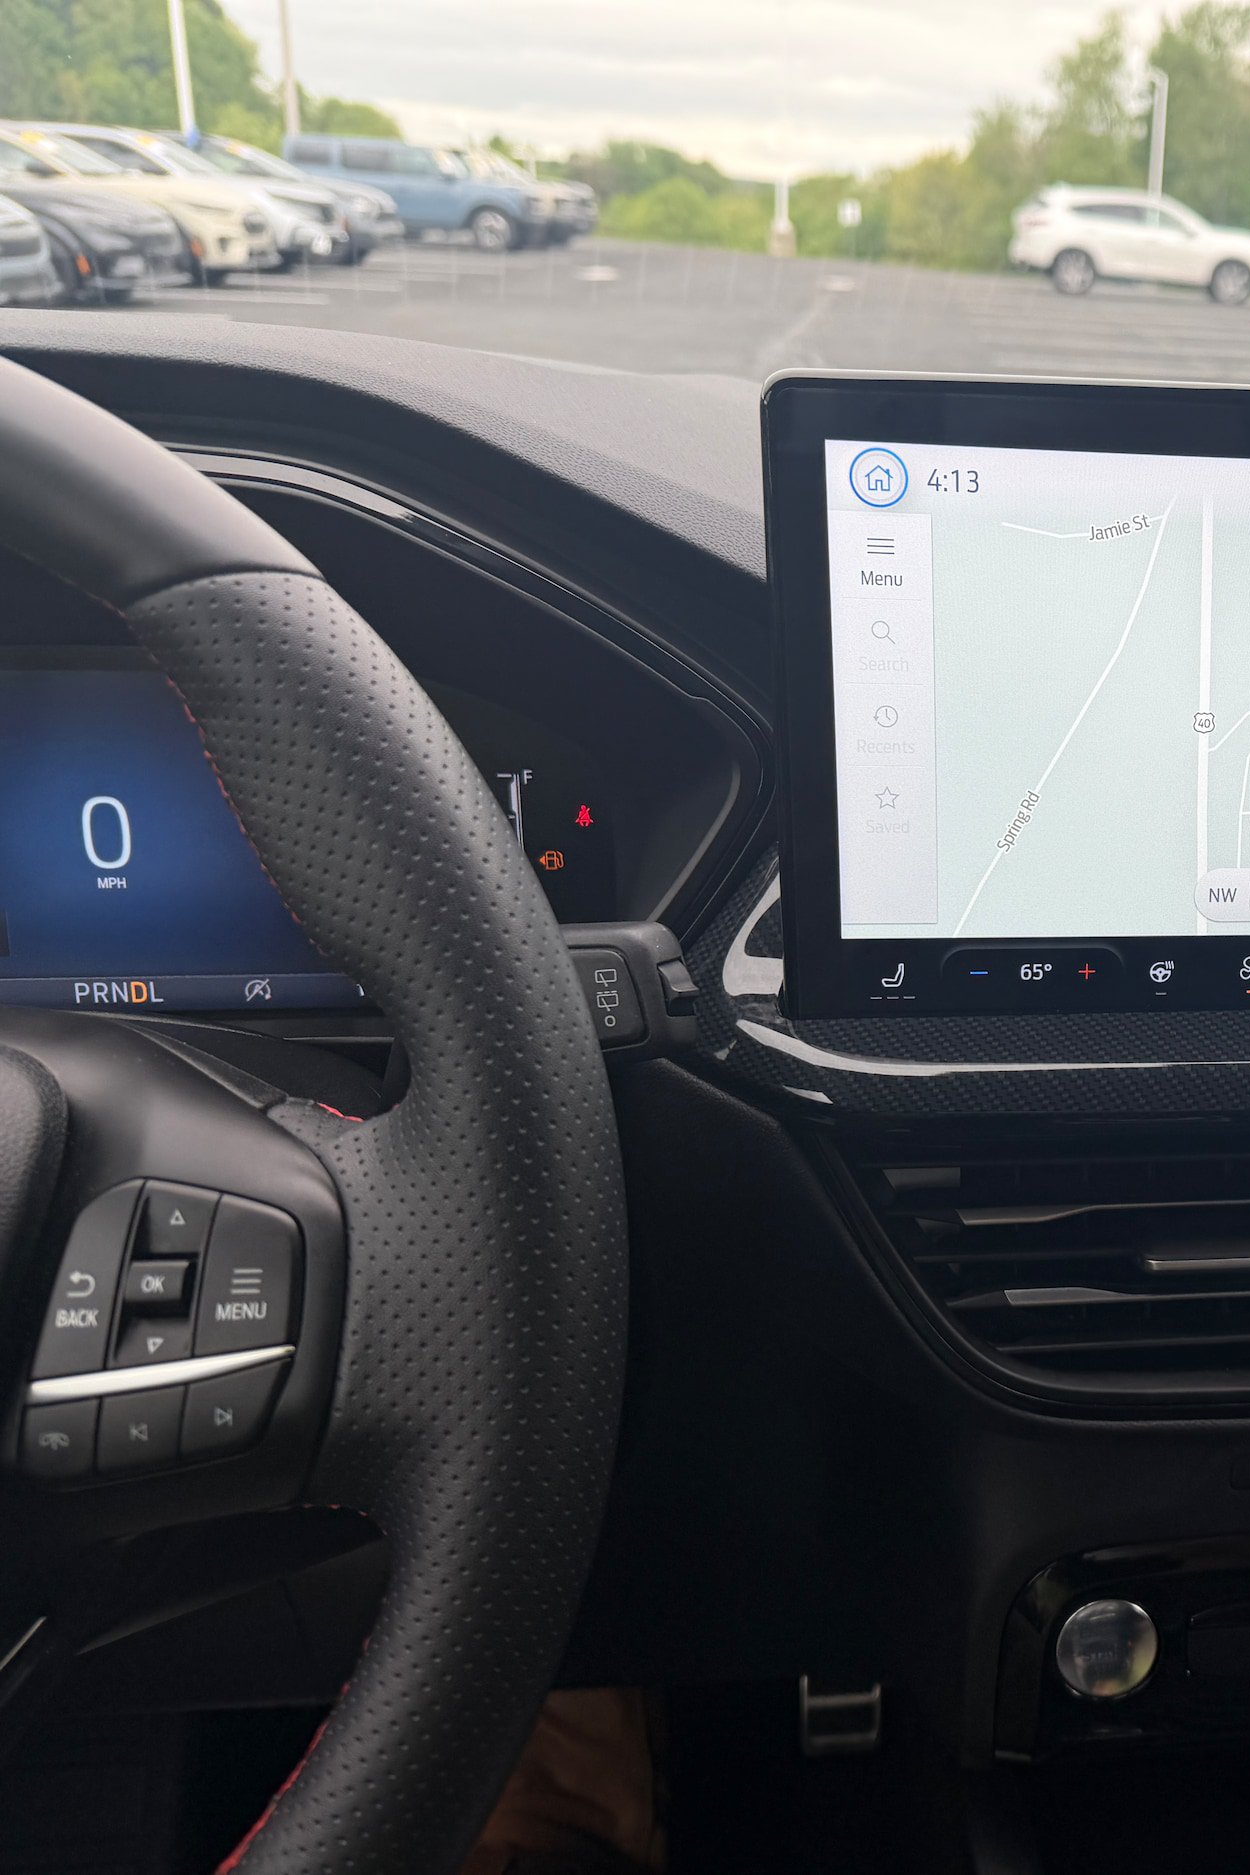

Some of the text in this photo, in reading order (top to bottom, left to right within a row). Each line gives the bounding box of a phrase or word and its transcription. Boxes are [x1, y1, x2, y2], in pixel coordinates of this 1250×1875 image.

[926, 467, 980, 494] 4:13
[1089, 514, 1150, 541] Jamie St
[860, 570, 904, 588] Menu
[858, 656, 910, 672] Search
[1197, 718, 1211, 729] 40
[857, 738, 916, 755] Recents
[522, 769, 533, 784] F
[866, 820, 910, 834] Saved
[997, 790, 1040, 852] Spring Rd
[81, 795, 132, 869] 0
[97, 876, 127, 889] MPH
[1208, 887, 1238, 903] NW
[1020, 962, 1053, 981] 65°
[141, 1274, 165, 1294] OK
[55, 1308, 100, 1329] BACK
[216, 1301, 268, 1322] MENU
